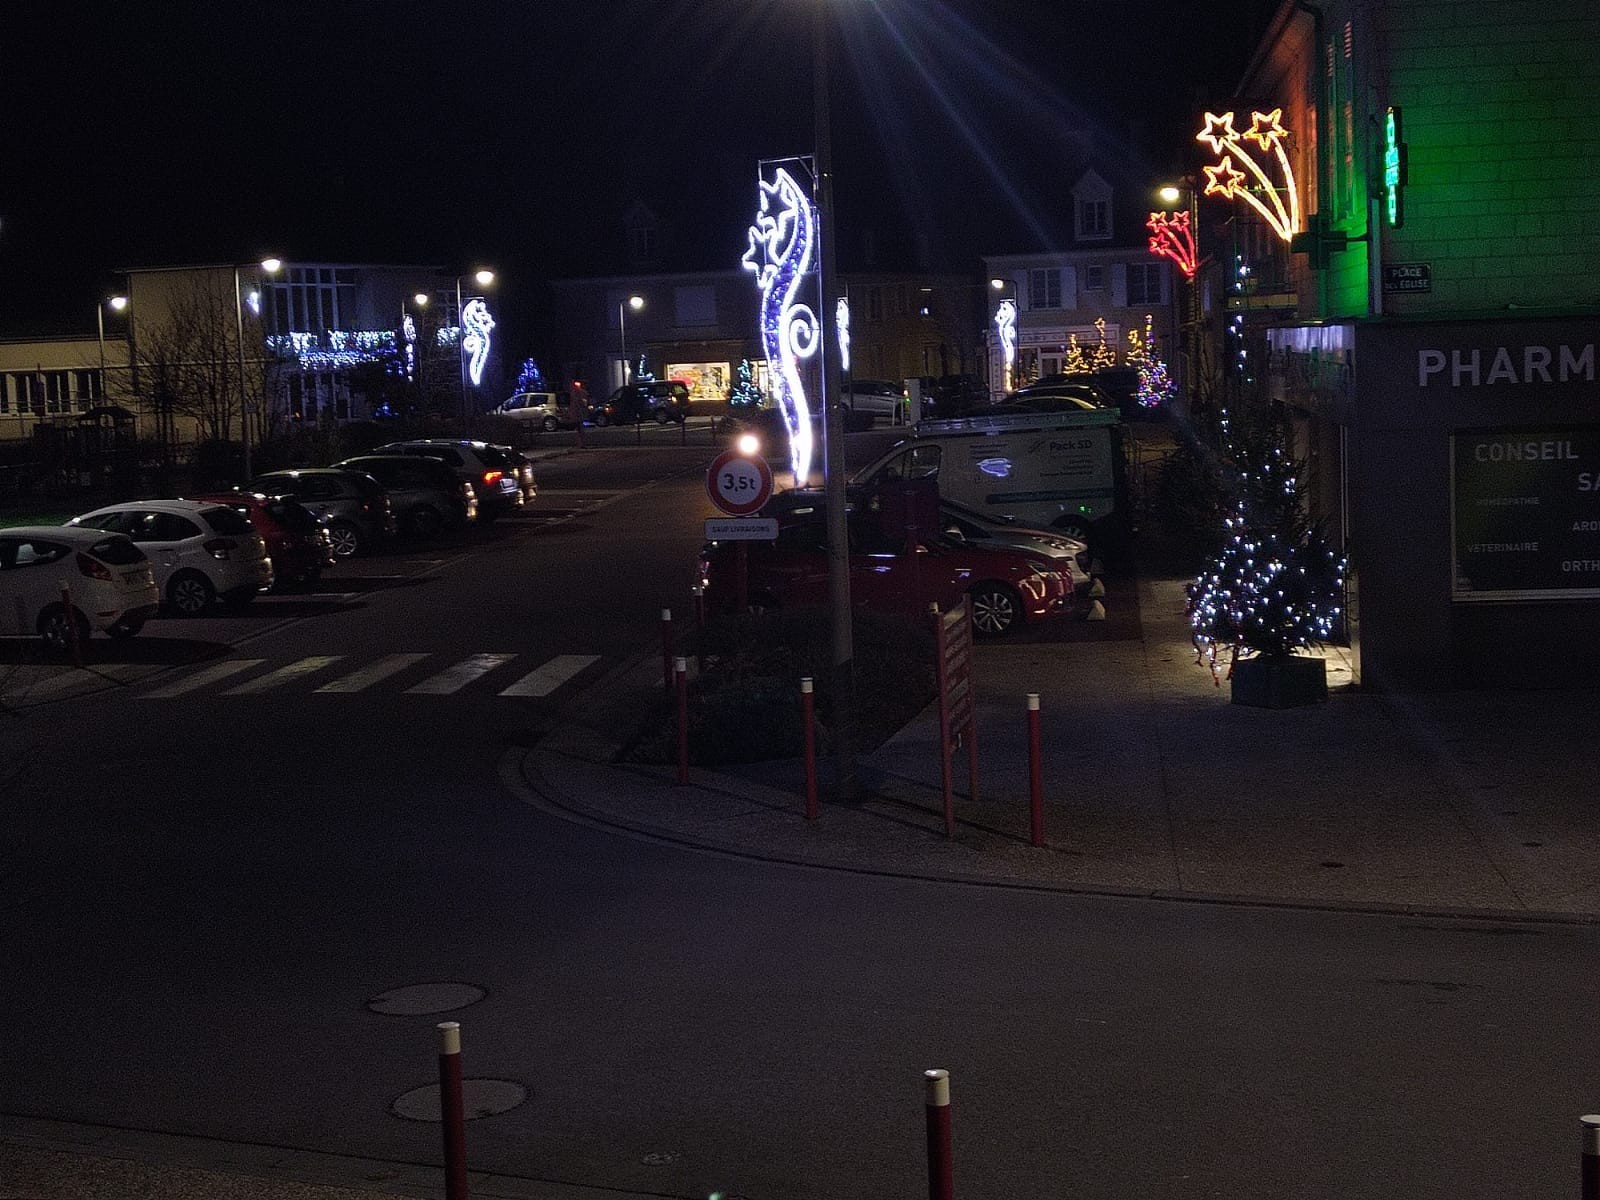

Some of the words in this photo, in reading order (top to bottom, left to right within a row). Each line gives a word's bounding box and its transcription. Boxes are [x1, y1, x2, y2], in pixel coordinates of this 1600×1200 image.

[1418, 343, 1595, 387] PHARM
[1049, 440, 1076, 451] Pack
[1474, 440, 1580, 462] CONSEIL
